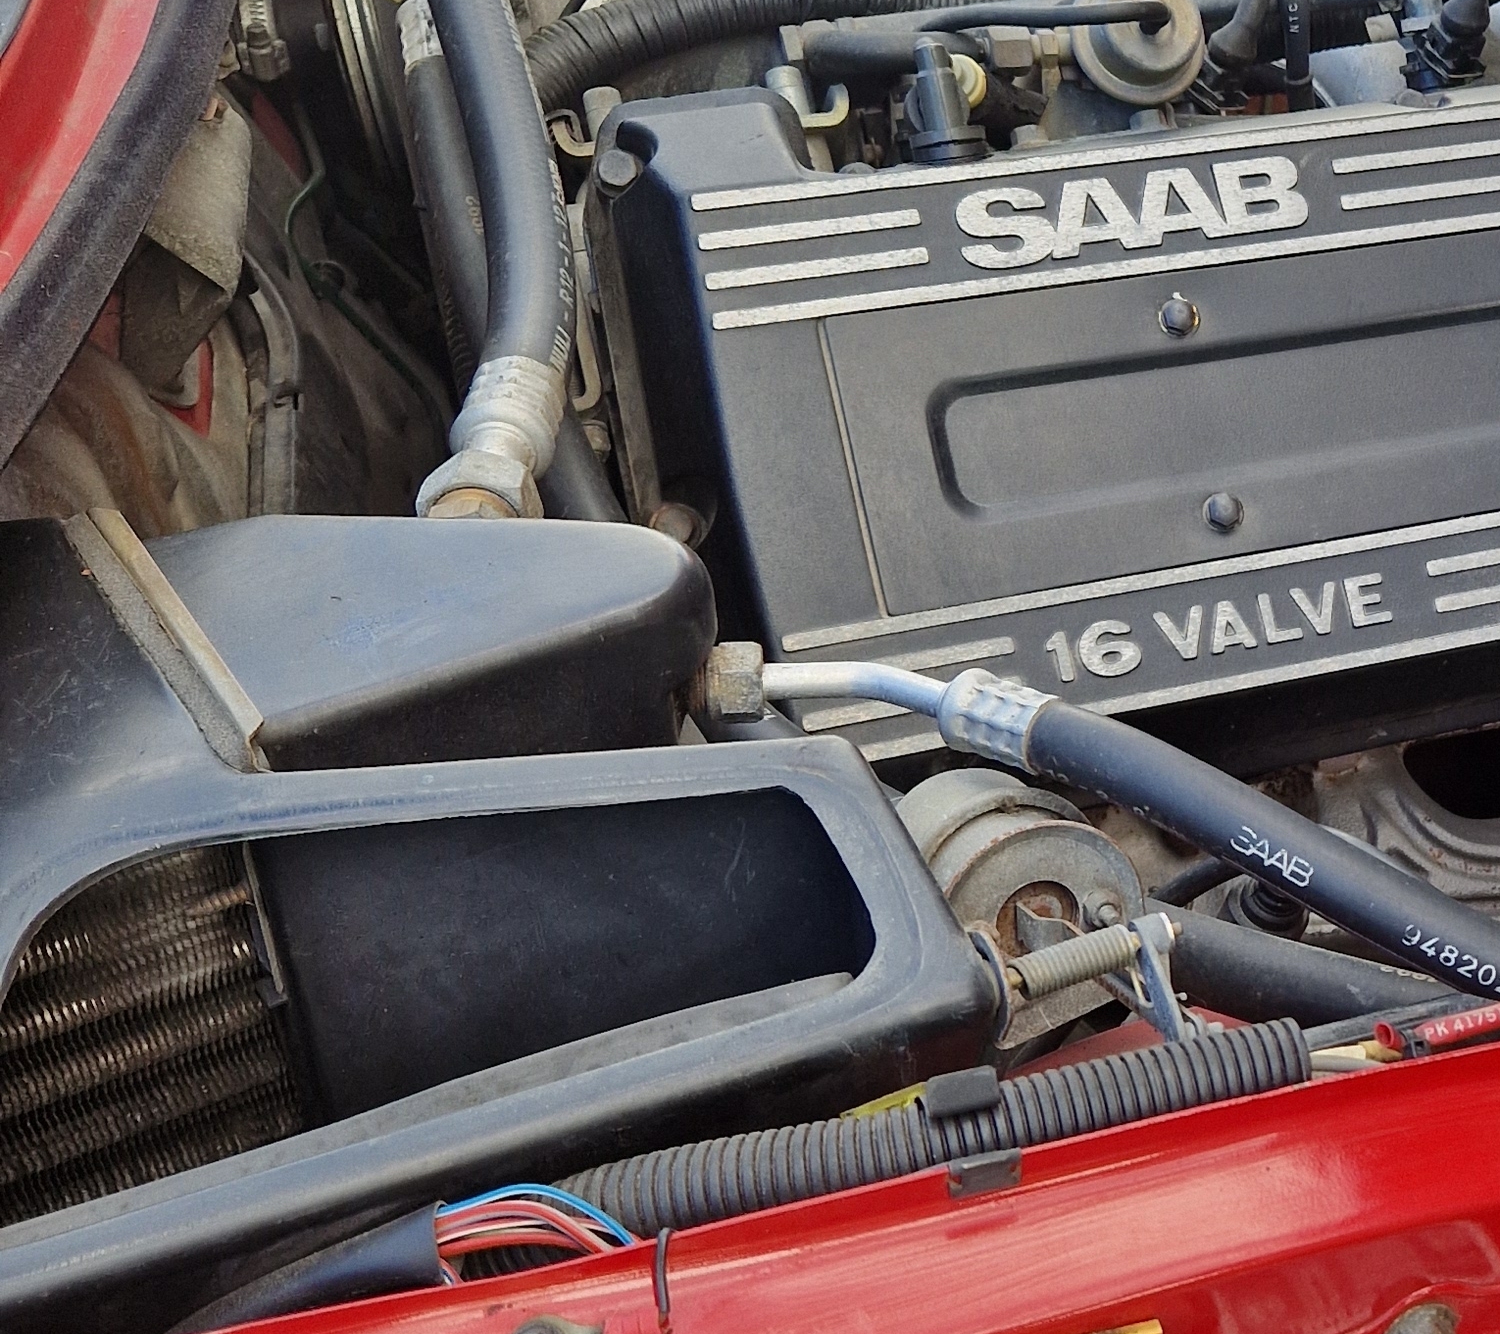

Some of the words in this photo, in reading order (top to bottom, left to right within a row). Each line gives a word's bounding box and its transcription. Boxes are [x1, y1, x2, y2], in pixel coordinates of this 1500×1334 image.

[1288, 2, 1300, 33] NTC
[955, 155, 1310, 271] SAAB
[1044, 619, 1143, 683] 16
[1152, 572, 1394, 660] VALVE
[1229, 825, 1315, 889] SAAB
[1423, 1023, 1450, 1041] PK
